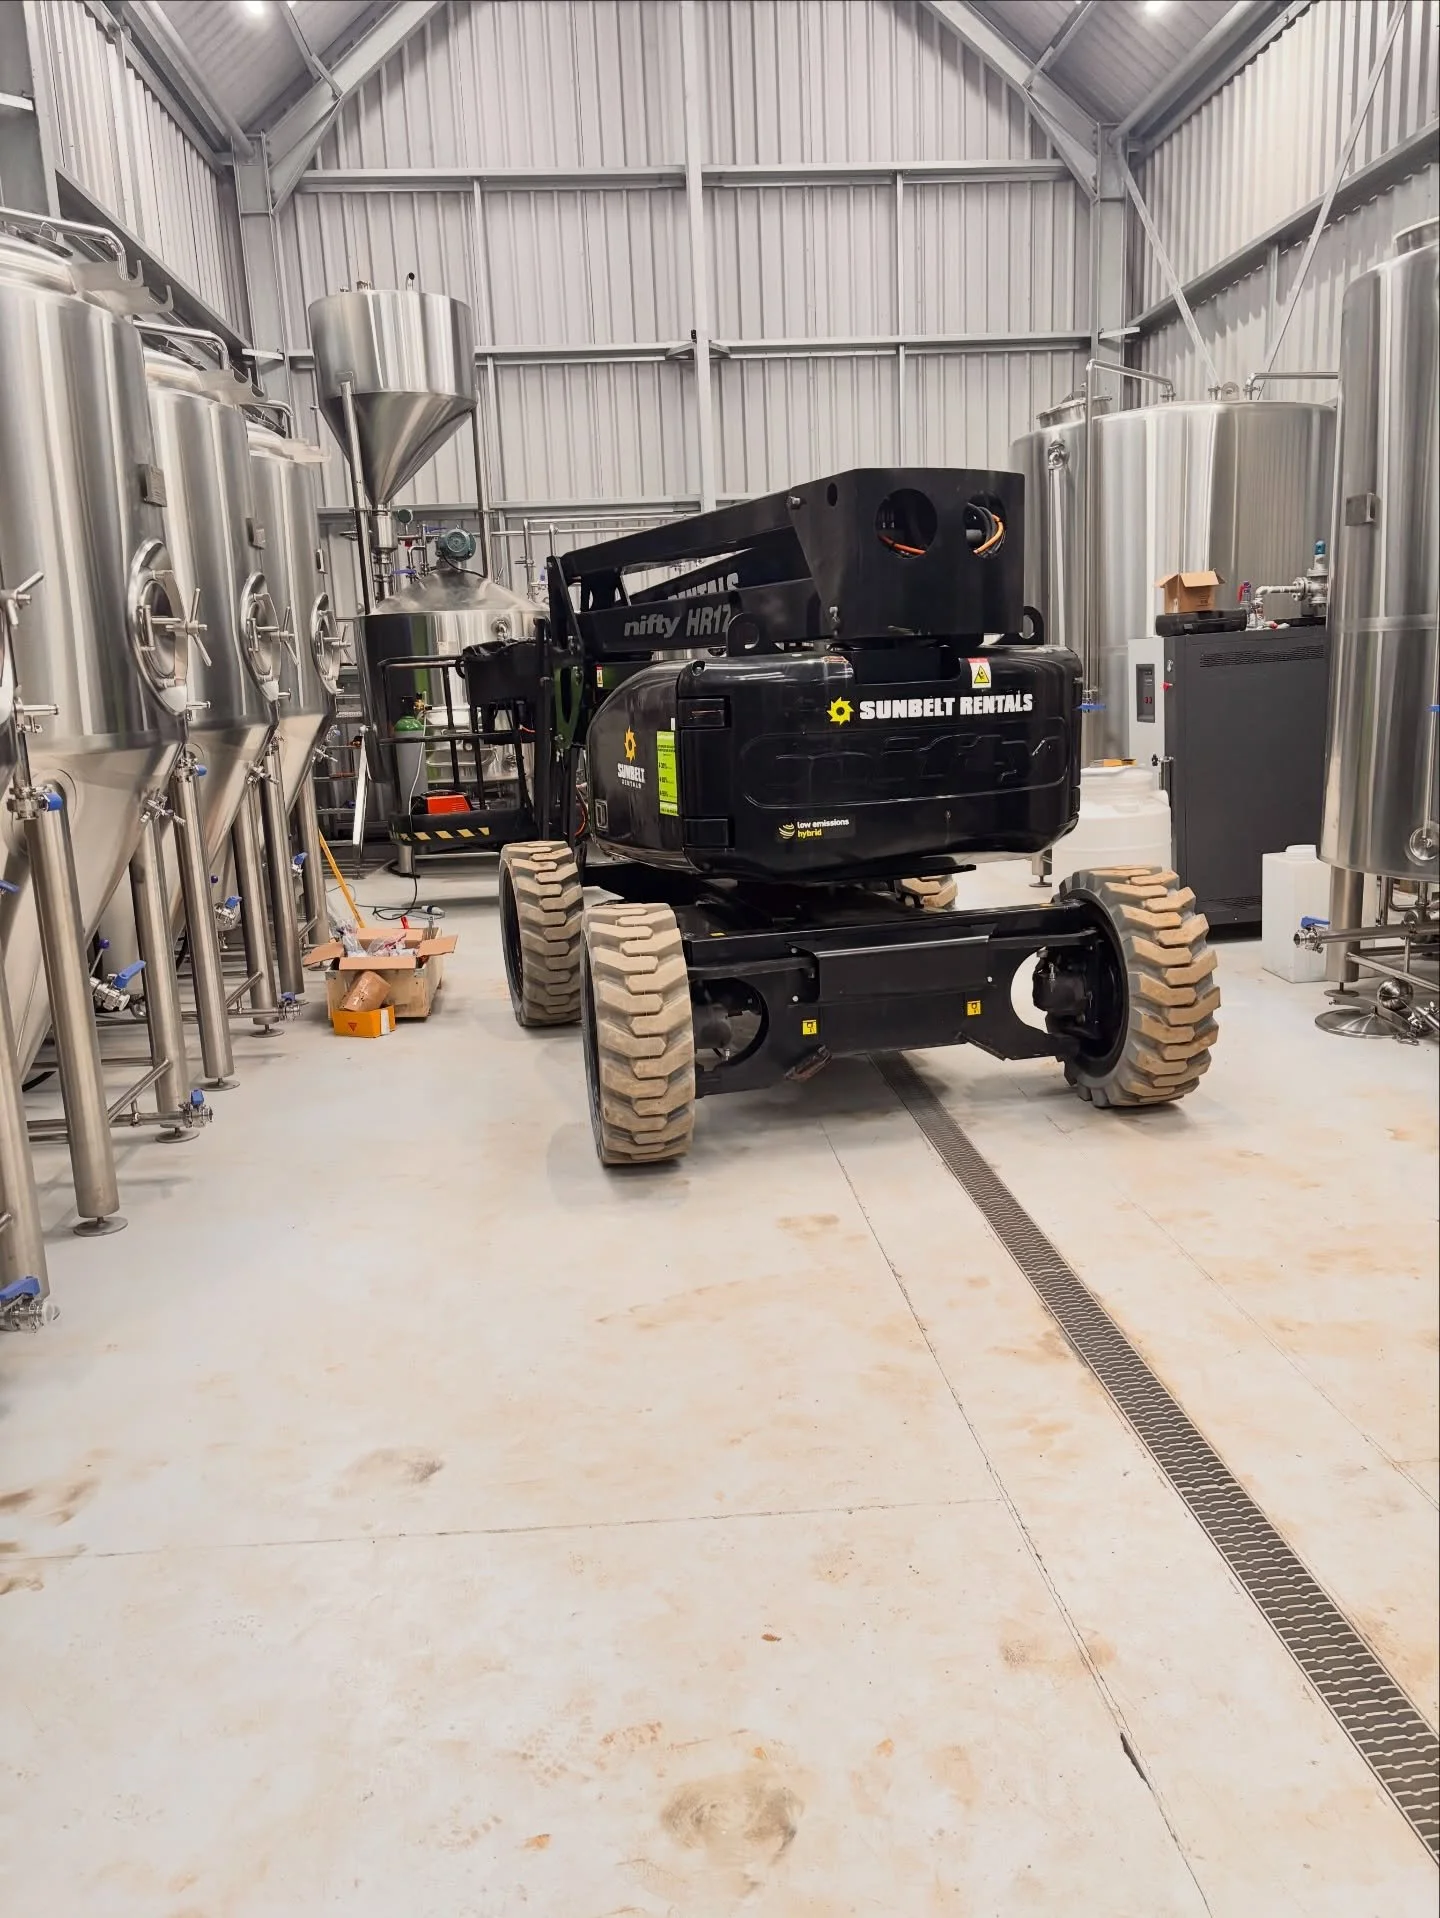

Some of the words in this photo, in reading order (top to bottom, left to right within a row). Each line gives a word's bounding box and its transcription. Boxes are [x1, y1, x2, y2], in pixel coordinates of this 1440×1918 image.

[624, 614, 680, 638] nifty
[859, 697, 955, 720] SUNBELT
[959, 693, 1033, 716] RENTALS
[618, 763, 646, 784] SUNBELT
[797, 821, 811, 829] low
[812, 819, 849, 828] emissions
[798, 829, 822, 838] hybrid
